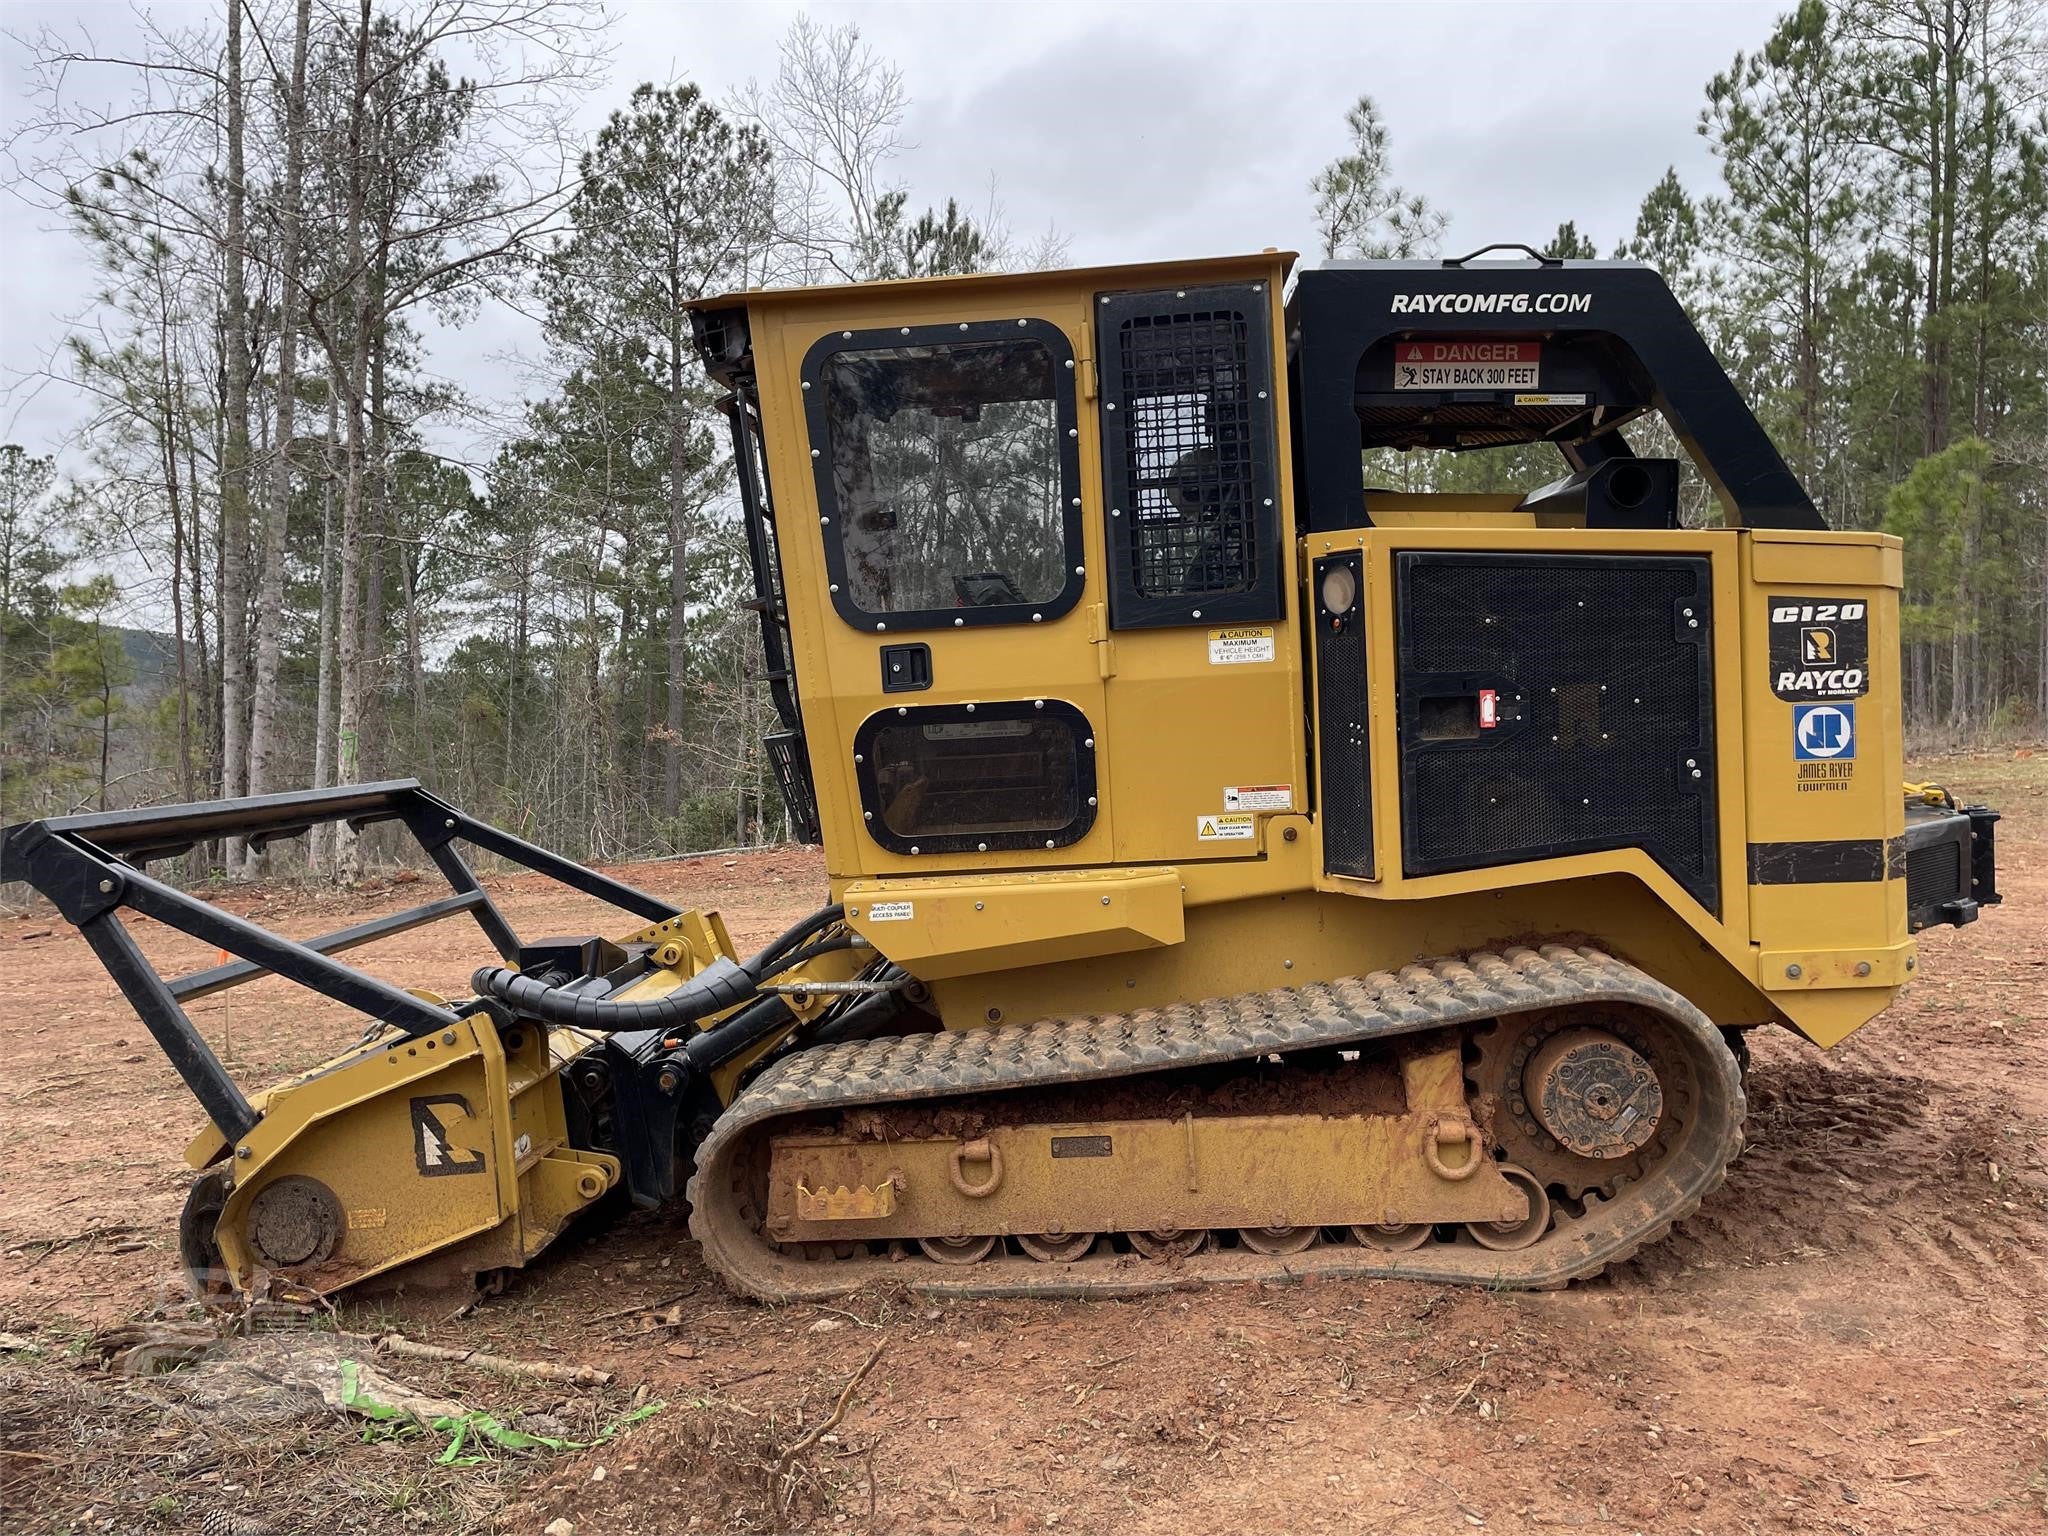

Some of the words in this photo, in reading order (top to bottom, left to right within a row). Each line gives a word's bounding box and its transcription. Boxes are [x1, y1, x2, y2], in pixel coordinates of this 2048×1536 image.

[1391, 294, 1592, 313] RAYCOMFG.COM
[1433, 344, 1519, 361] DANGER
[1422, 368, 1451, 384] STAY
[1453, 368, 1485, 384] BACK
[1486, 368, 1505, 384] 300
[1508, 368, 1536, 385] FEET
[1523, 396, 1549, 404] CAUTION
[1772, 604, 1865, 623] C120
[1227, 630, 1263, 638] CAUTION
[1214, 647, 1242, 655] VEHICLE
[1777, 669, 1863, 691] RAYCO
[1797, 763, 1827, 779] JAMES
